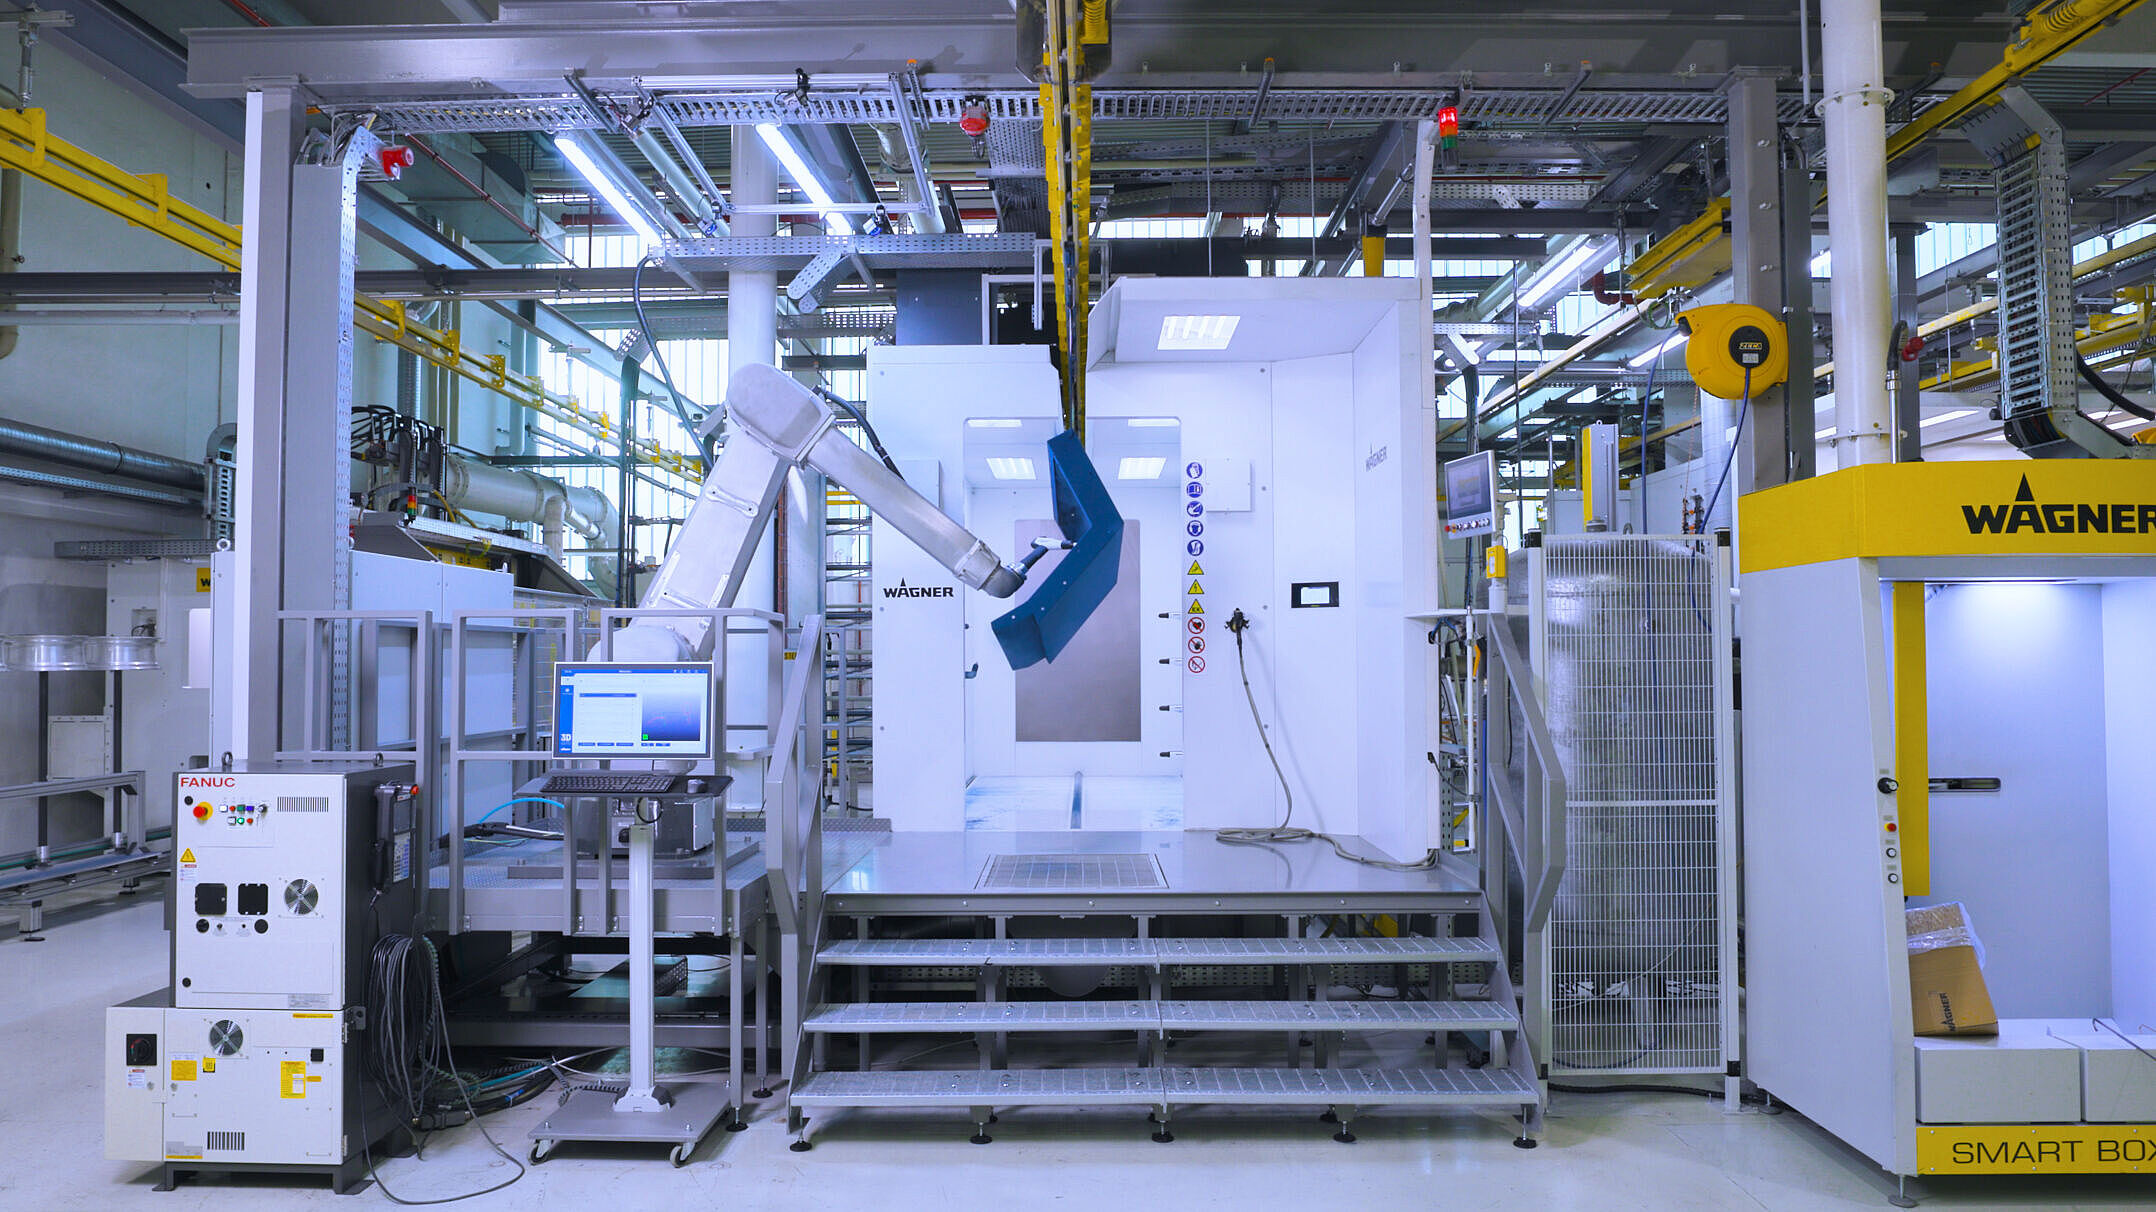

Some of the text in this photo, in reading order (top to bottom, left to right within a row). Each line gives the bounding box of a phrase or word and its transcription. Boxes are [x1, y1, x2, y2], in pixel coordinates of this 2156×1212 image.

[883, 577, 954, 598] WAGNER
[180, 777, 236, 788] FANUC
[1952, 1141, 2083, 1164] SMART
